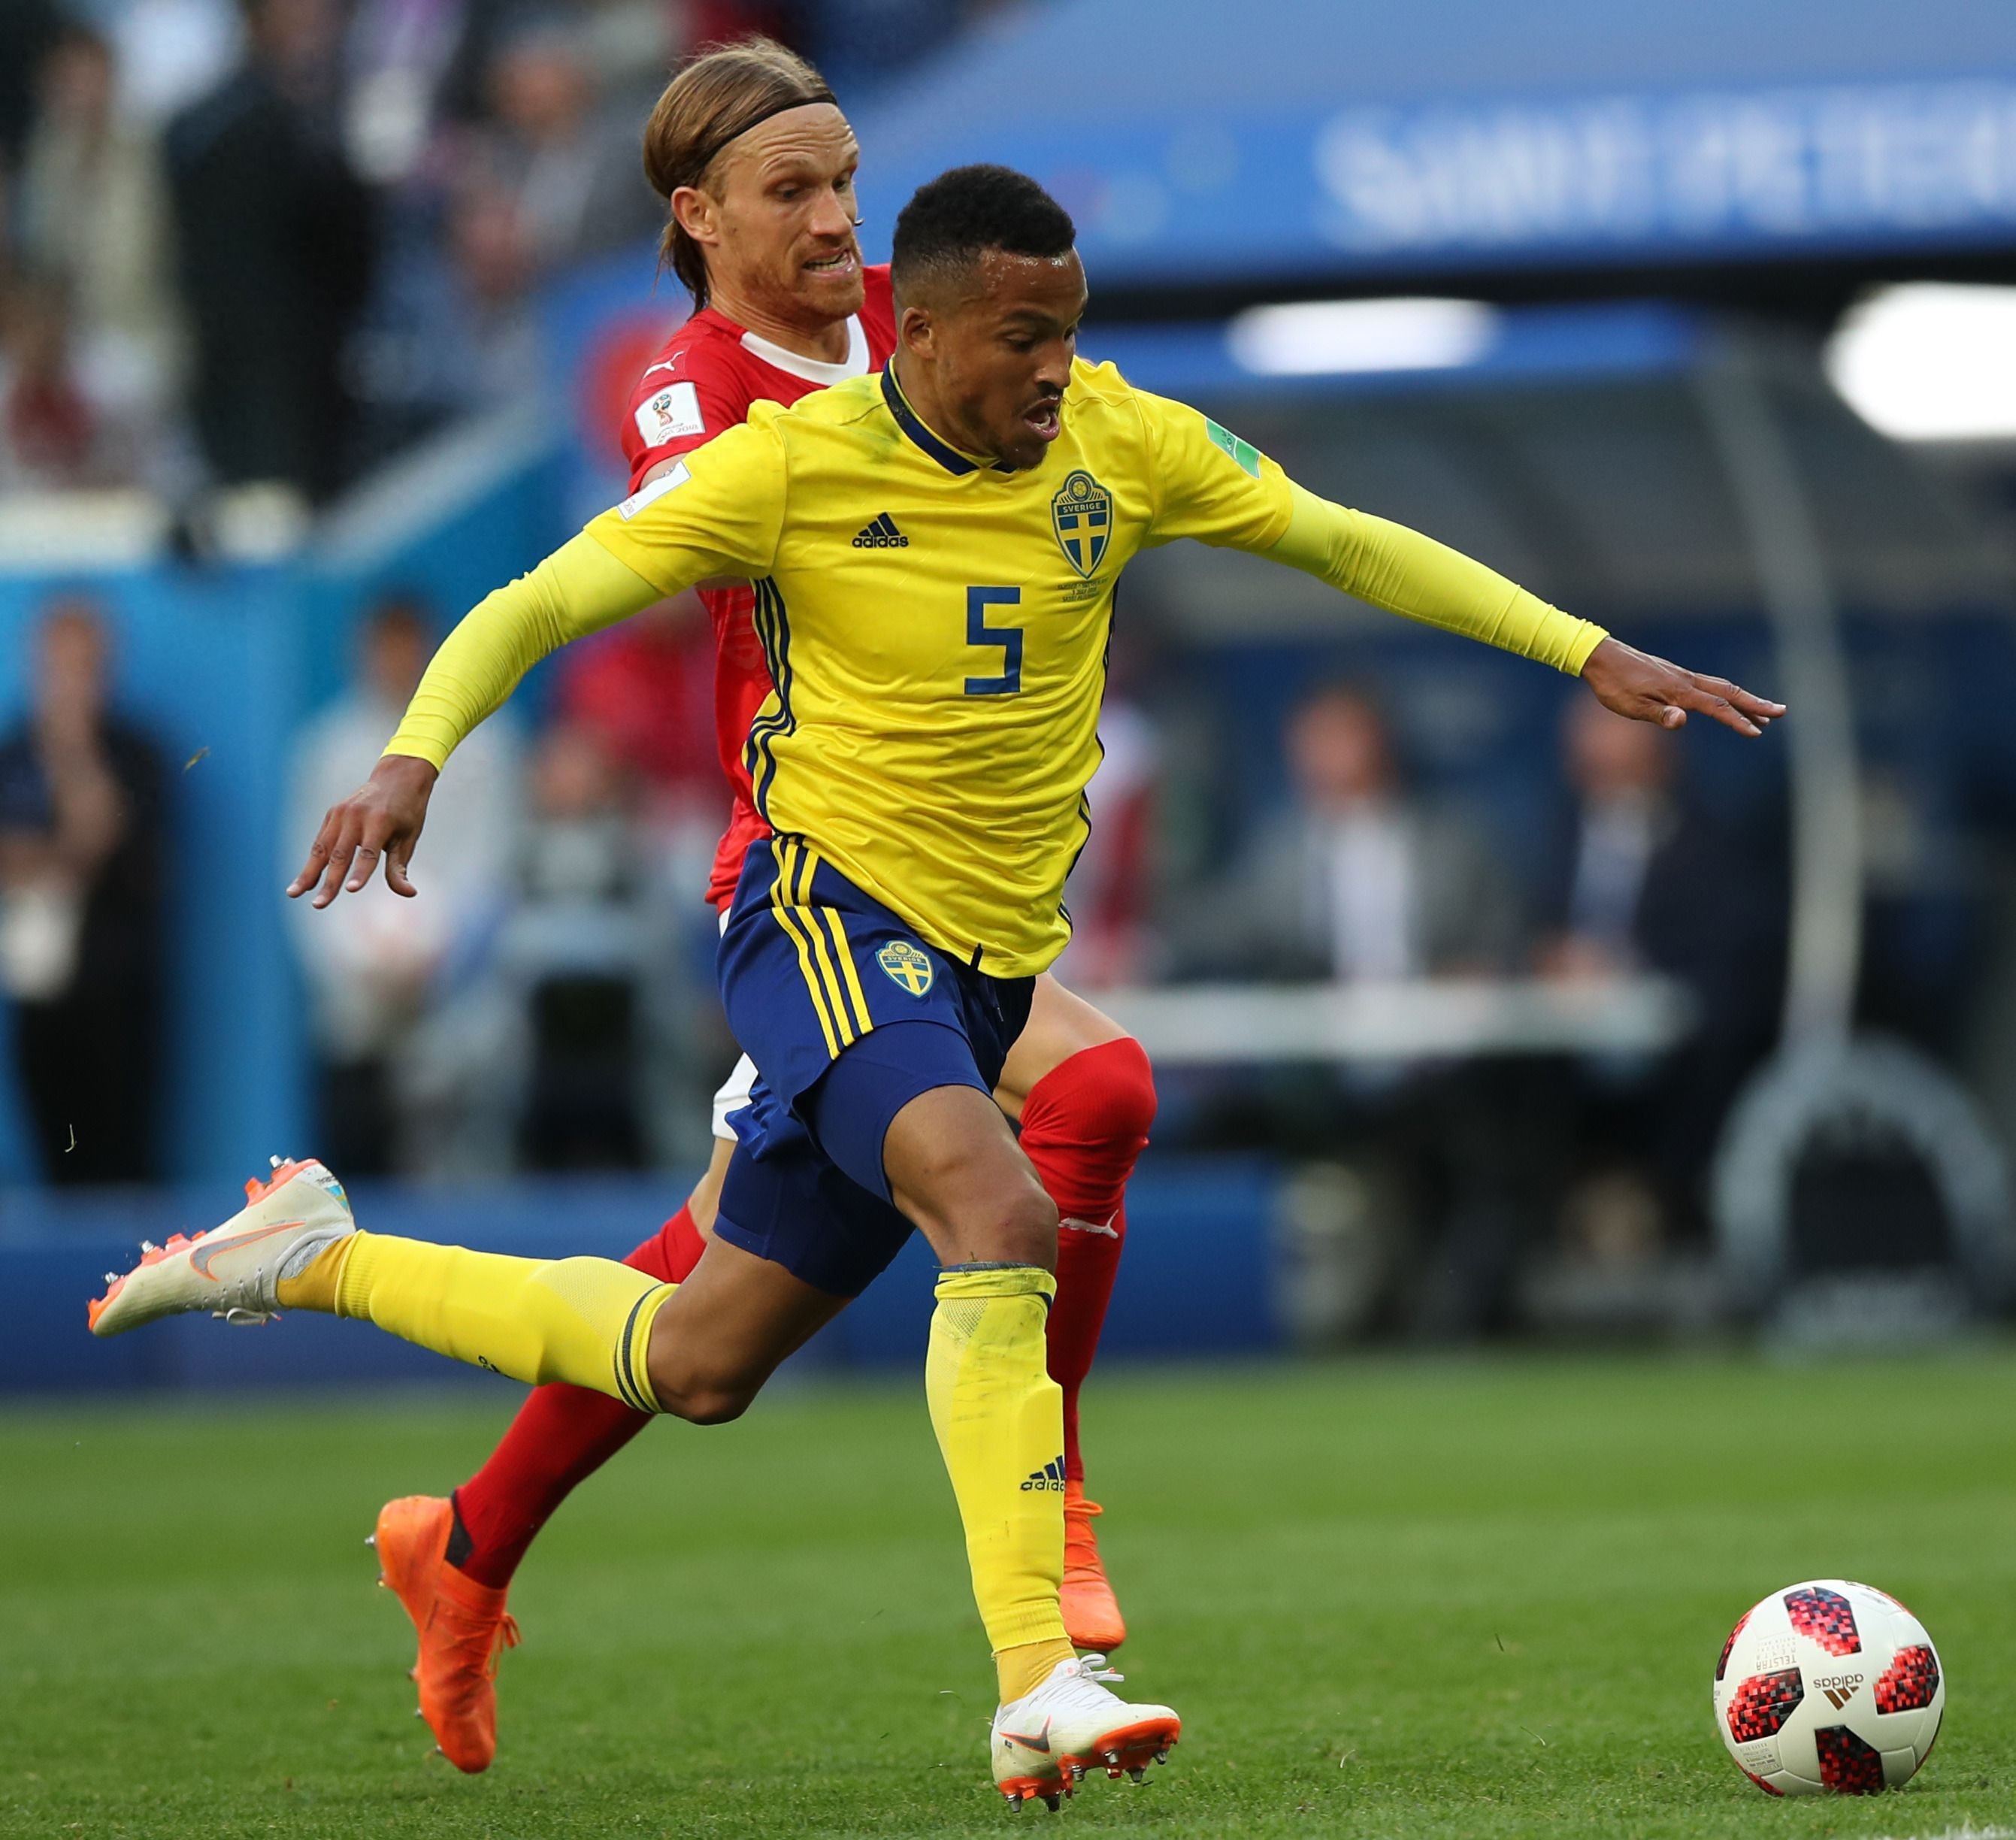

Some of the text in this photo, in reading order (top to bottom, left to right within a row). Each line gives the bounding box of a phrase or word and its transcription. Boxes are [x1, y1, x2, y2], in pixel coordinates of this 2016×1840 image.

[1063, 502, 1101, 513] SVERIGE
[852, 535, 909, 548] adidas
[964, 586, 1023, 695] 5
[1020, 1478, 1065, 1491] adida
[1813, 1673, 1864, 1689] adidas
